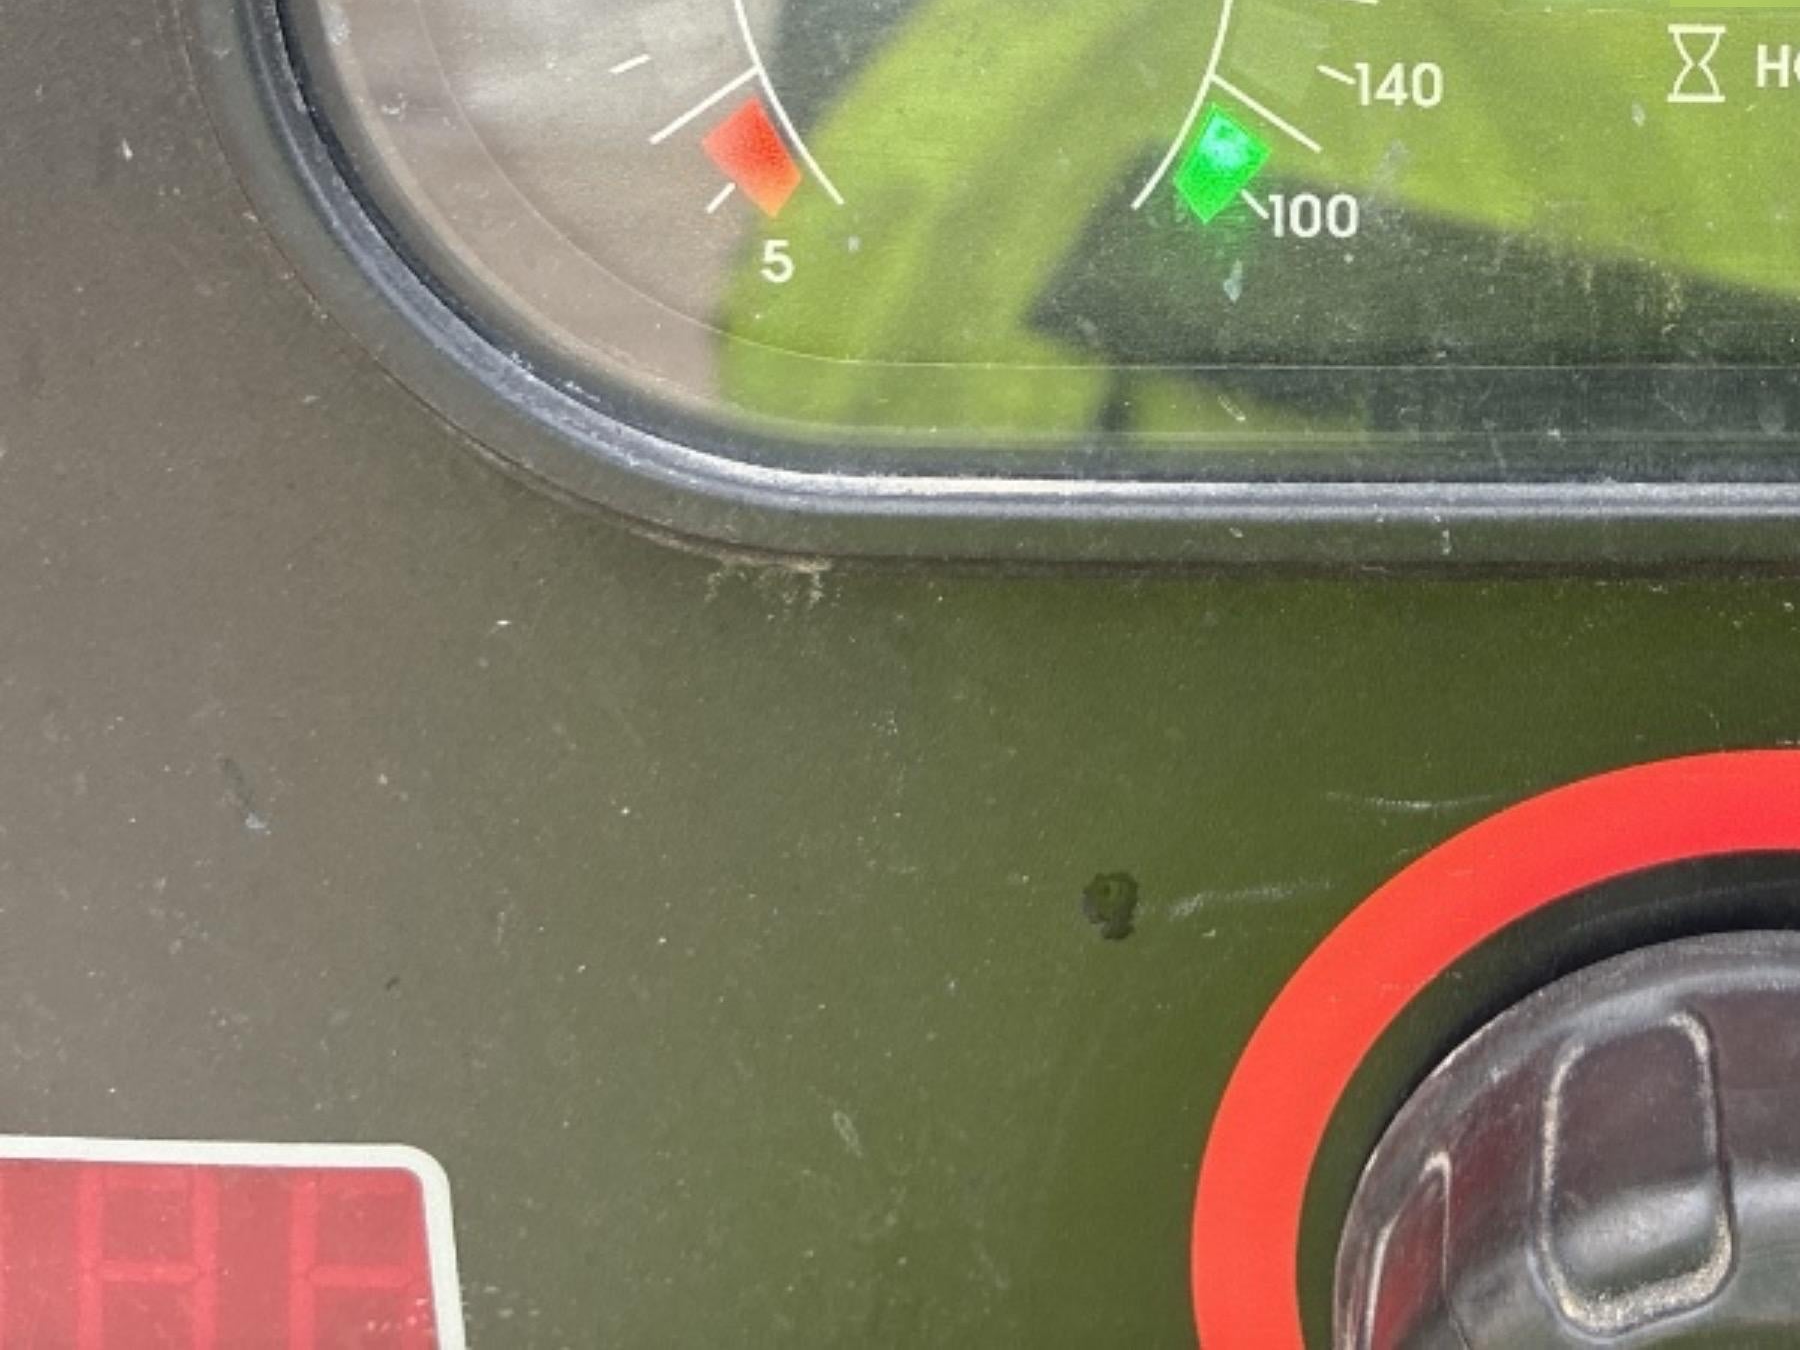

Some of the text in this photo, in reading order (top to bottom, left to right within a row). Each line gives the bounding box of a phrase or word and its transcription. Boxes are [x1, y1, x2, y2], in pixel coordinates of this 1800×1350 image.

[1353, 62, 1443, 108] 140
[1268, 194, 1359, 238] 100
[760, 240, 793, 284] 5
